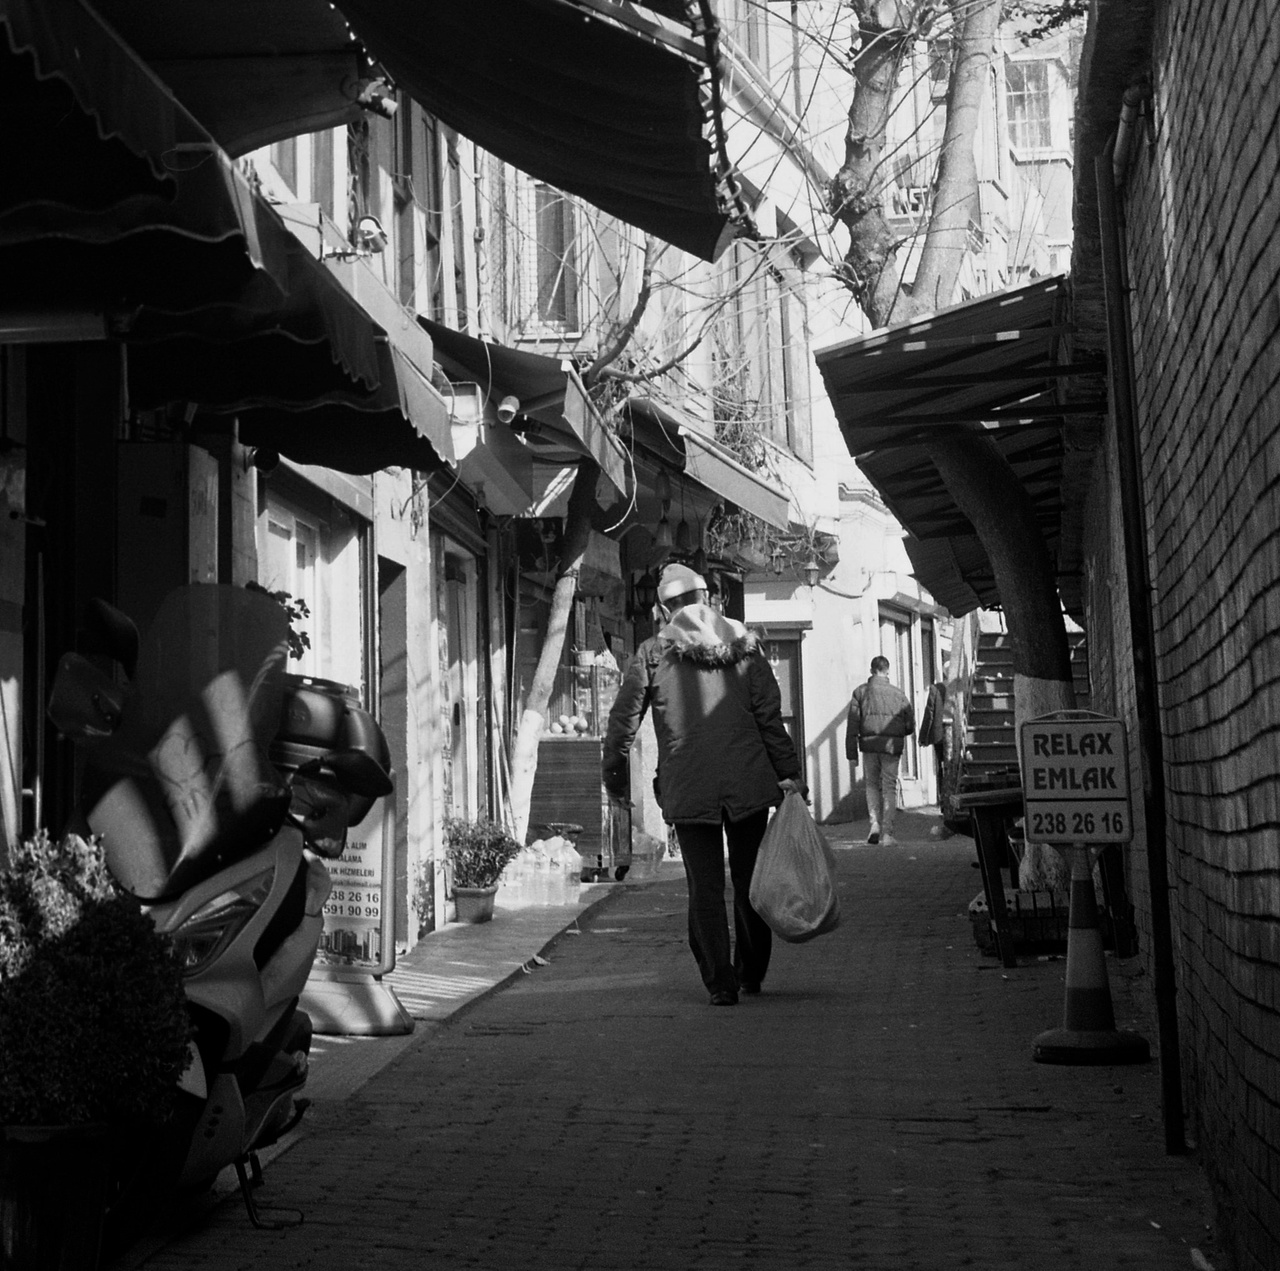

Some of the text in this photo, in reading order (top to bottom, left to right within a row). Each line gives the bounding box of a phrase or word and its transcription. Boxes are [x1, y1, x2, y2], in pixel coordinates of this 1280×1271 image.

[1032, 732, 1114, 758] RELAX
[1032, 766, 1118, 792] EMLAK
[1032, 812, 1124, 835] 238 26 16
[348, 891, 362, 902] 26
[366, 893, 379, 903] 16
[348, 905, 362, 916] 90
[365, 907, 379, 917] 99
